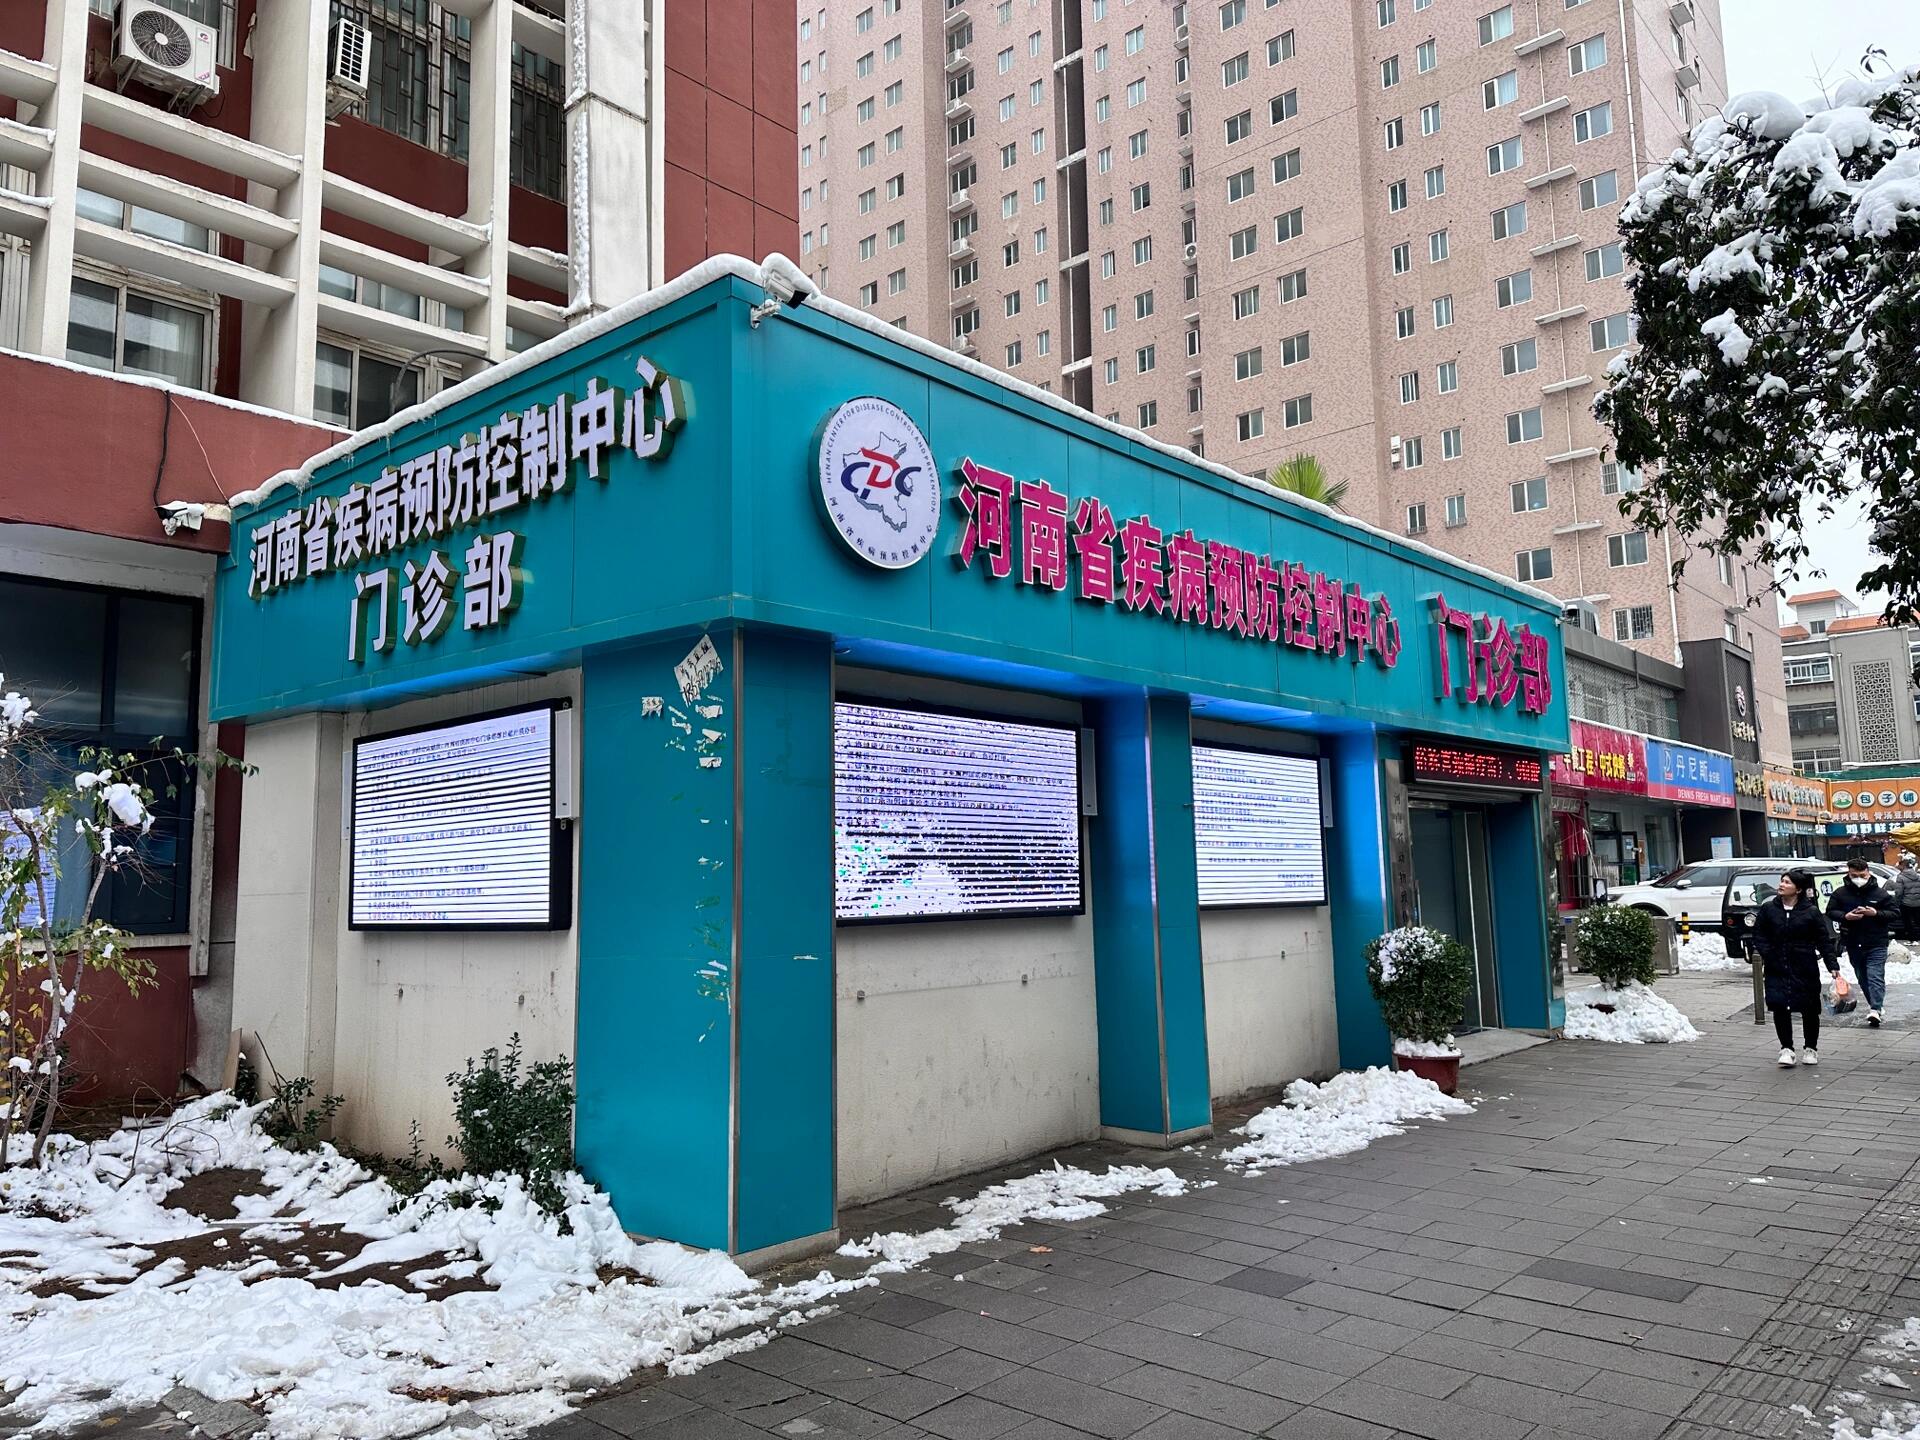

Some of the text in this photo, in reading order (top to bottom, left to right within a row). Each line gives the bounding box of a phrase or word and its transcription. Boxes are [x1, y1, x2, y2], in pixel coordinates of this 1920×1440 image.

[248, 355, 682, 598] 河南省疾病预防控制中心
[828, 419, 844, 448] CENTER
[843, 409, 856, 420] FOR
[856, 403, 885, 412] DISEASE
[885, 407, 915, 436] CONTROL
[914, 436, 926, 454] AND
[924, 455, 937, 513] PREVENTION
[841, 447, 921, 500] CDC
[347, 531, 520, 661] 门诊部
[957, 457, 1552, 715] 河南省疾病预防控制中心 门诊部
[1676, 755, 1708, 783] 丹尼斯
[1678, 789, 1694, 799] DENNIS
[1696, 791, 1709, 801] FRESH
[1861, 792, 1914, 803] 包子铺
